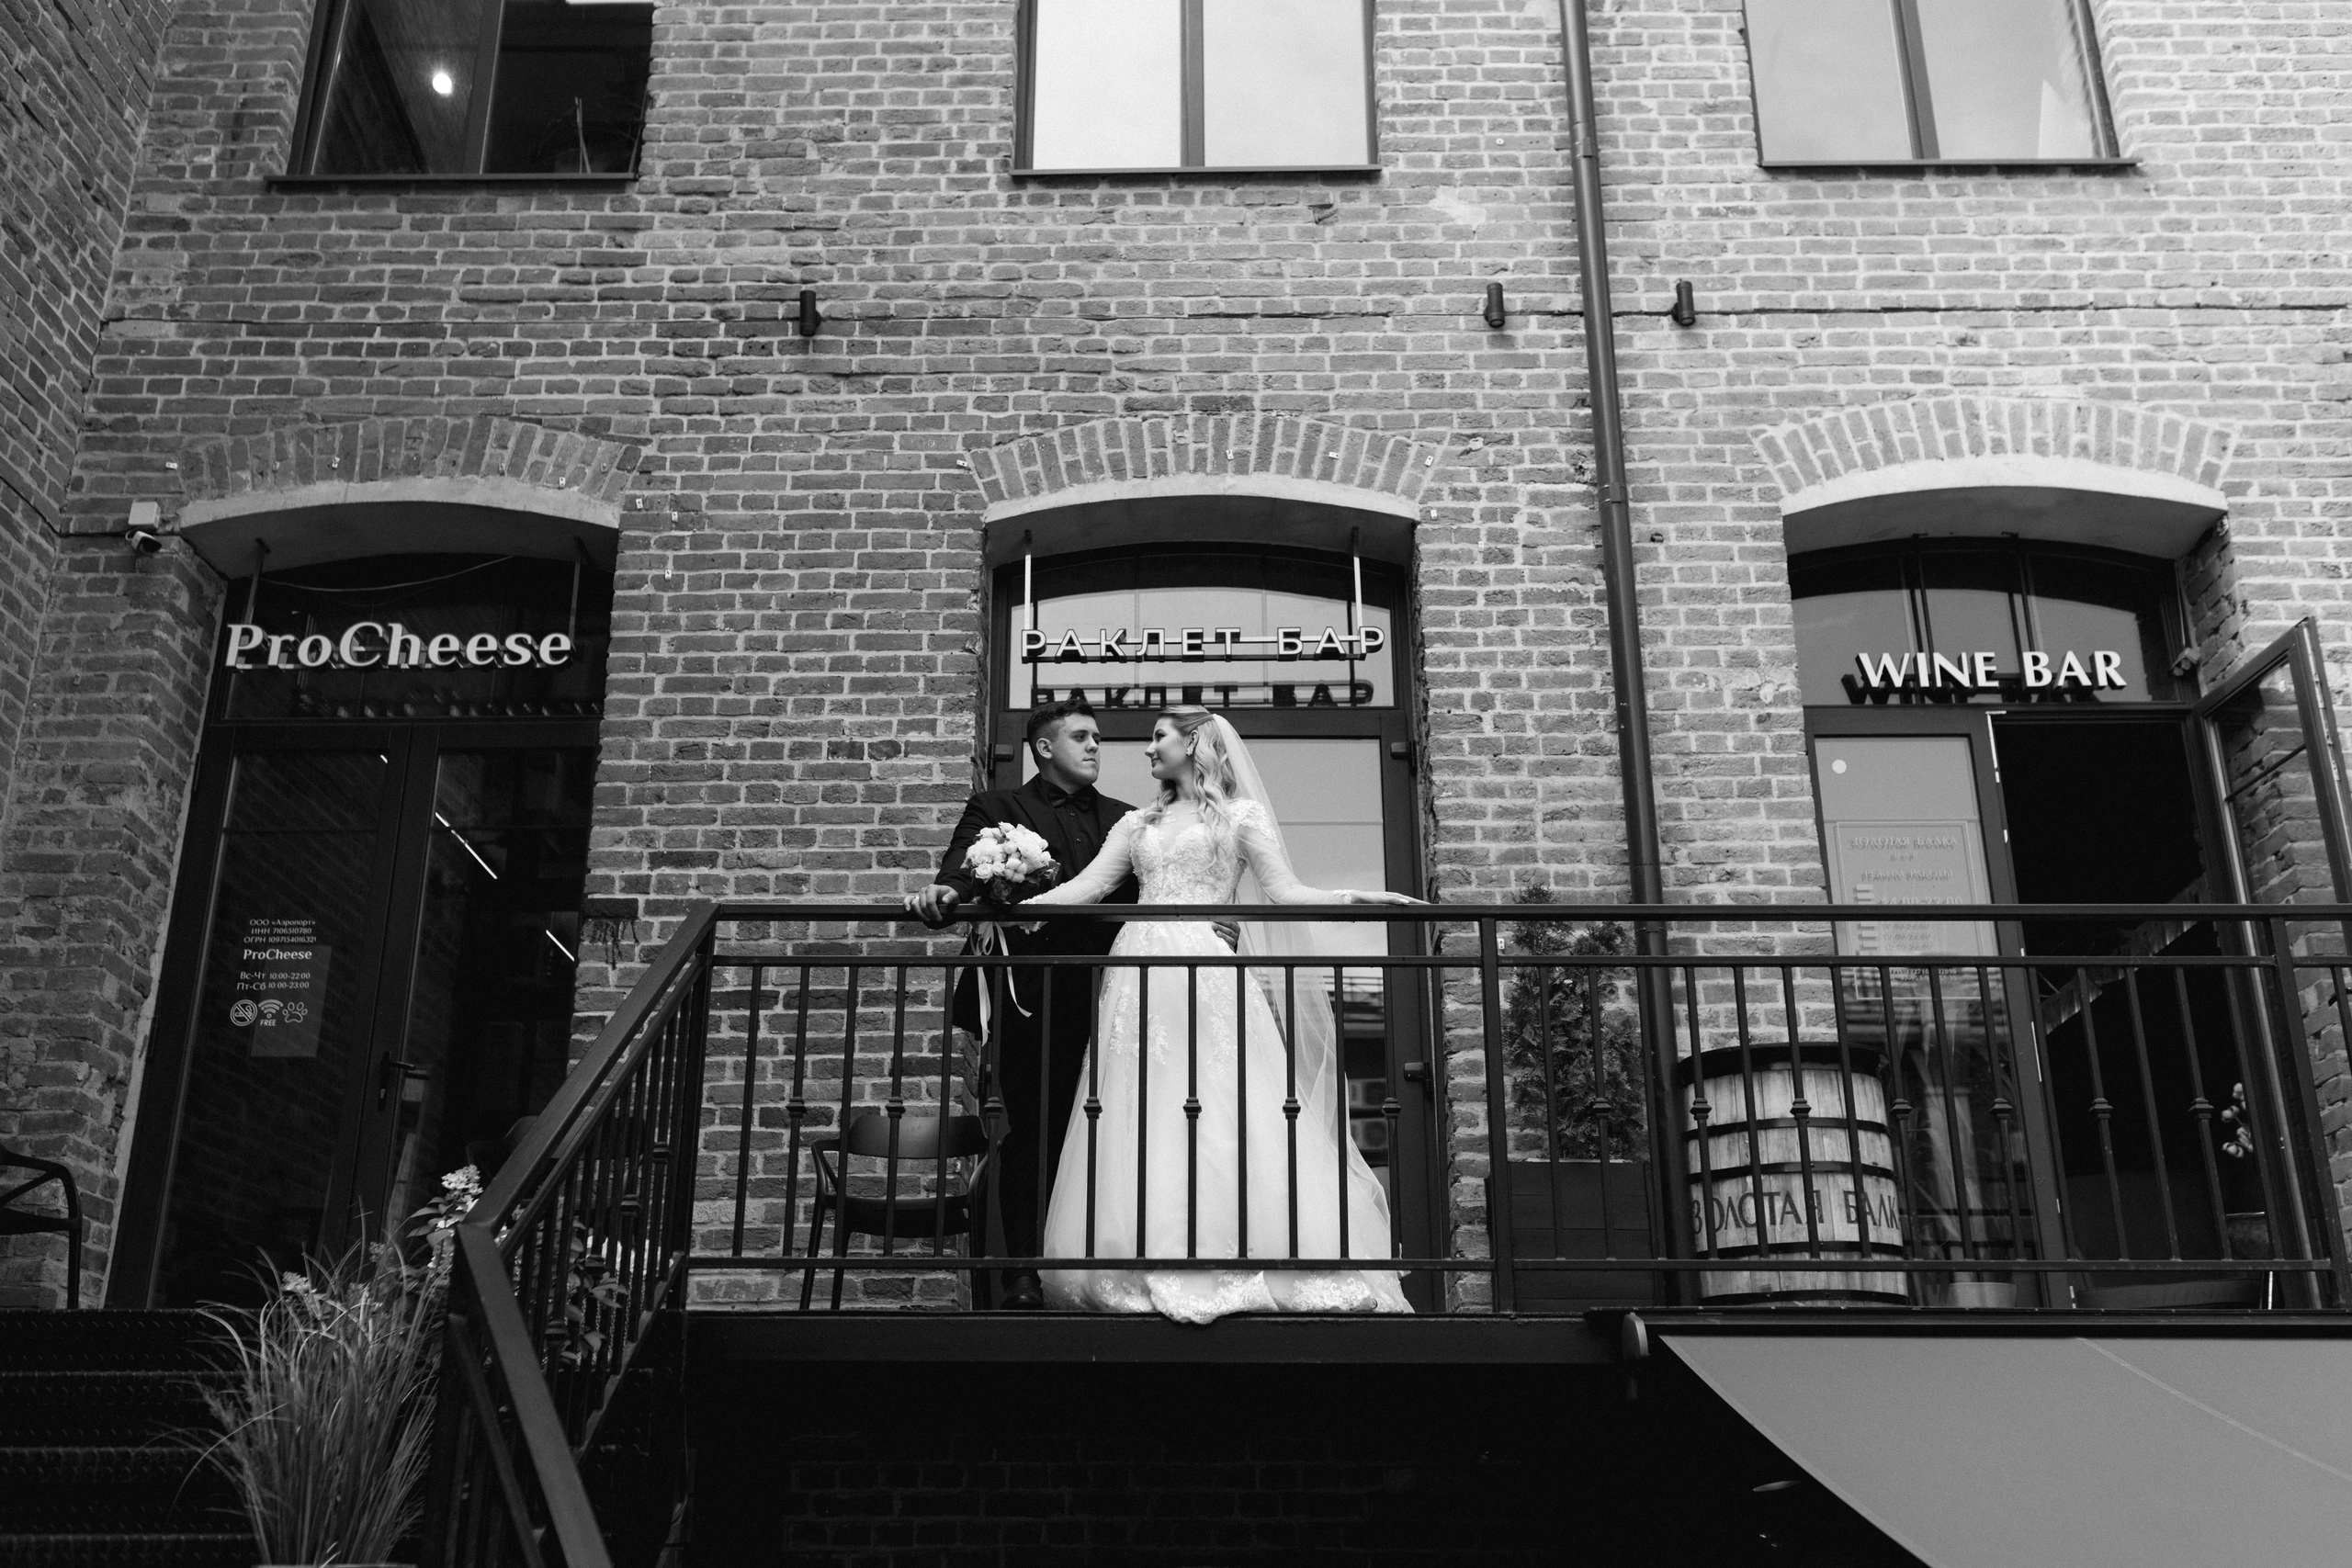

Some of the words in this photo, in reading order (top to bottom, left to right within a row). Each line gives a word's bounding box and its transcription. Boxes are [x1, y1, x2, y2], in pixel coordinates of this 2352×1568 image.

[225, 621, 571, 667] ProCheese
[1021, 627, 1241, 660] РАКЛЕТ
[1277, 626, 1385, 659] БАР
[1857, 651, 1999, 688] WINE
[2022, 650, 2127, 688] BAR
[271, 919, 316, 927] «Аэропорт»
[243, 949, 312, 961] ProCheese
[240, 971, 266, 980] Вс-Чт
[269, 972, 311, 980] 10:00-22:00
[236, 982, 266, 991] Пт-Сб
[267, 981, 310, 989] 10:00-23:00
[259, 1019, 277, 1027] FREE
